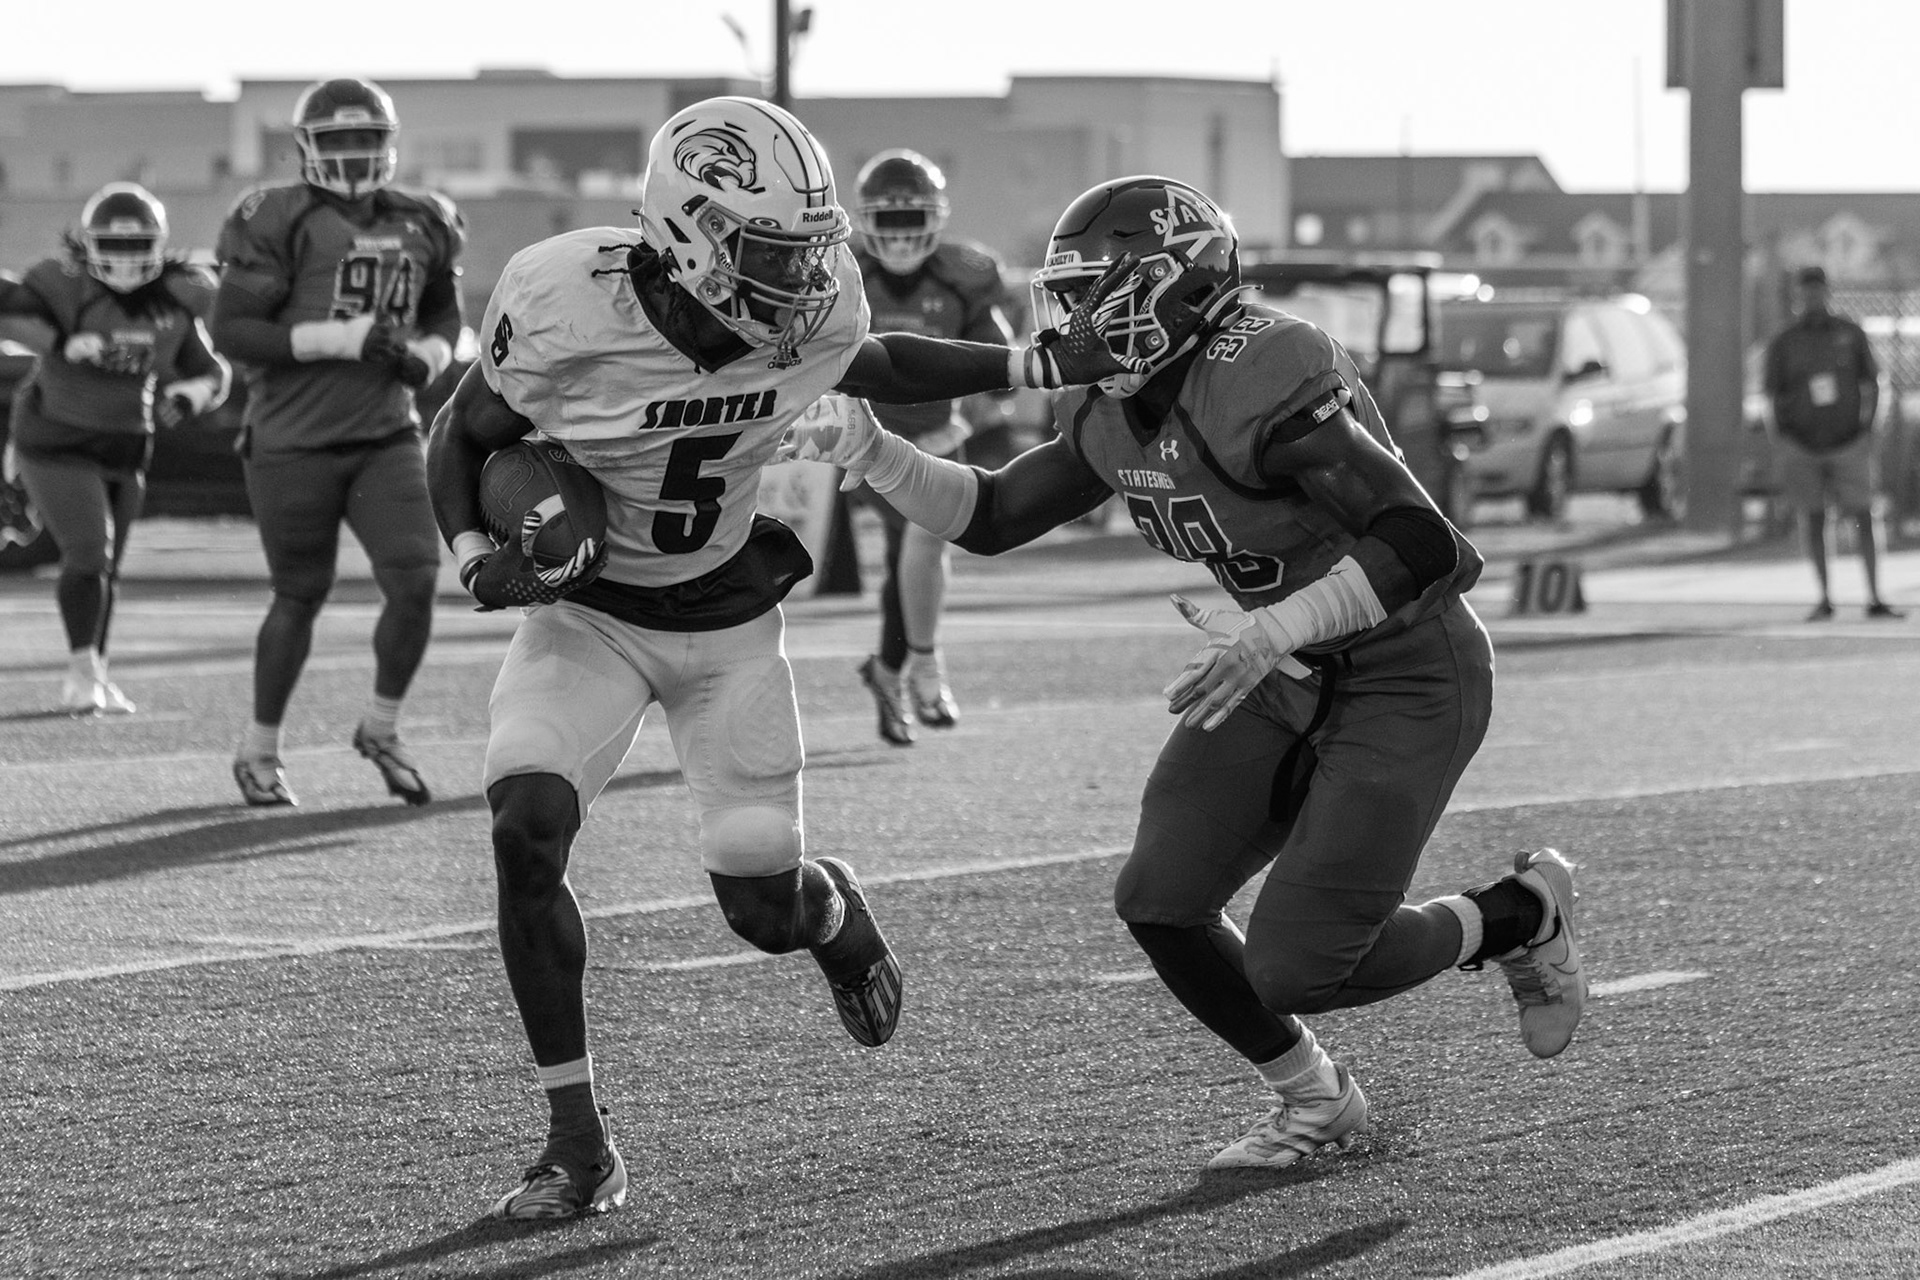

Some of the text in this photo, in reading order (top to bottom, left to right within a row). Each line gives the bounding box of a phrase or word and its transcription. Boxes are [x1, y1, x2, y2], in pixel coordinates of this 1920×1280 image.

[802, 209, 833, 223] Riddell
[638, 389, 777, 430] SHORTER
[651, 430, 744, 555] 5
[1117, 469, 1176, 490] STATESMEN
[1517, 562, 1570, 615] 10
